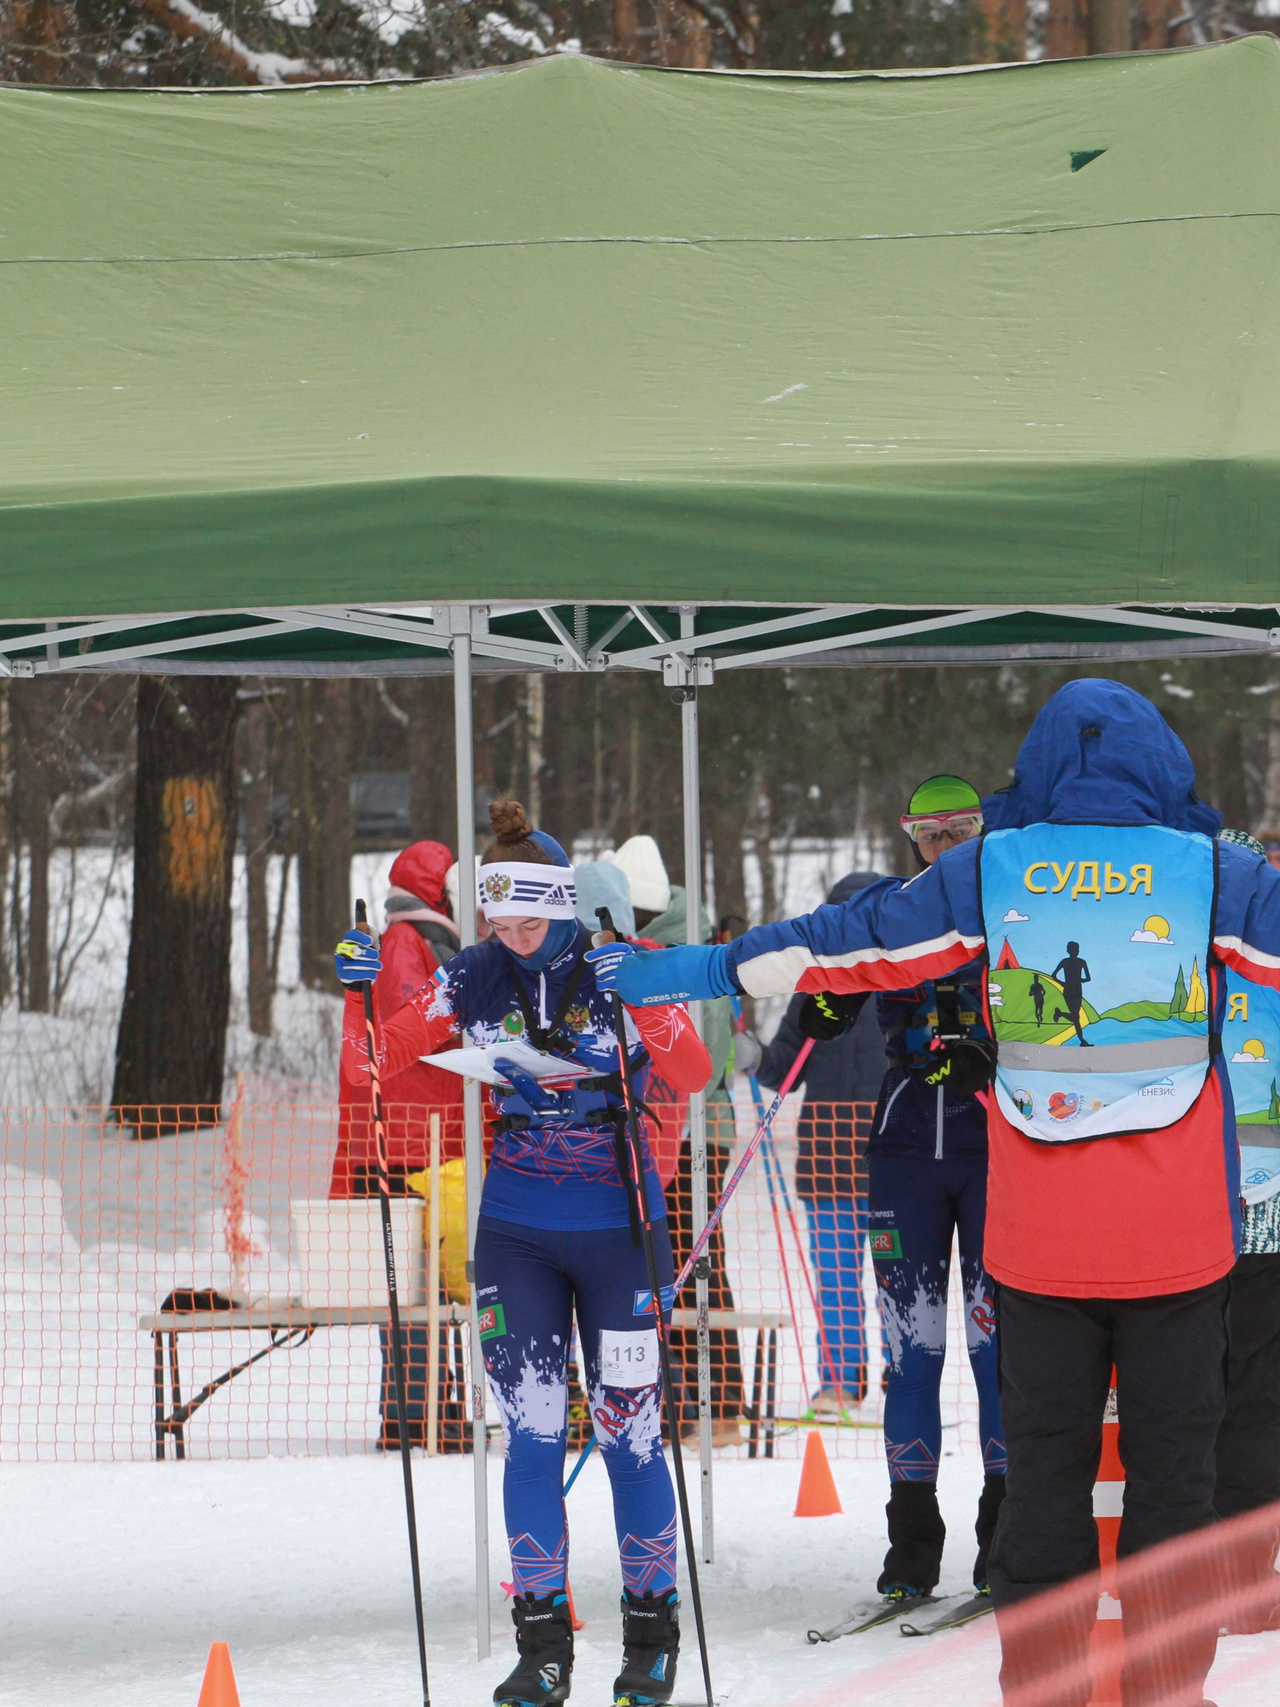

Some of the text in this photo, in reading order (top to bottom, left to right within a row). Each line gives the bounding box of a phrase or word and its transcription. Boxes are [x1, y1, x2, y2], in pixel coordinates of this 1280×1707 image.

[1023, 860, 1153, 902] СУДЬЯ
[544, 898, 567, 906] adidas
[612, 1346, 646, 1362] 113
[525, 1613, 554, 1621] salomon
[629, 1610, 658, 1618] salomon
